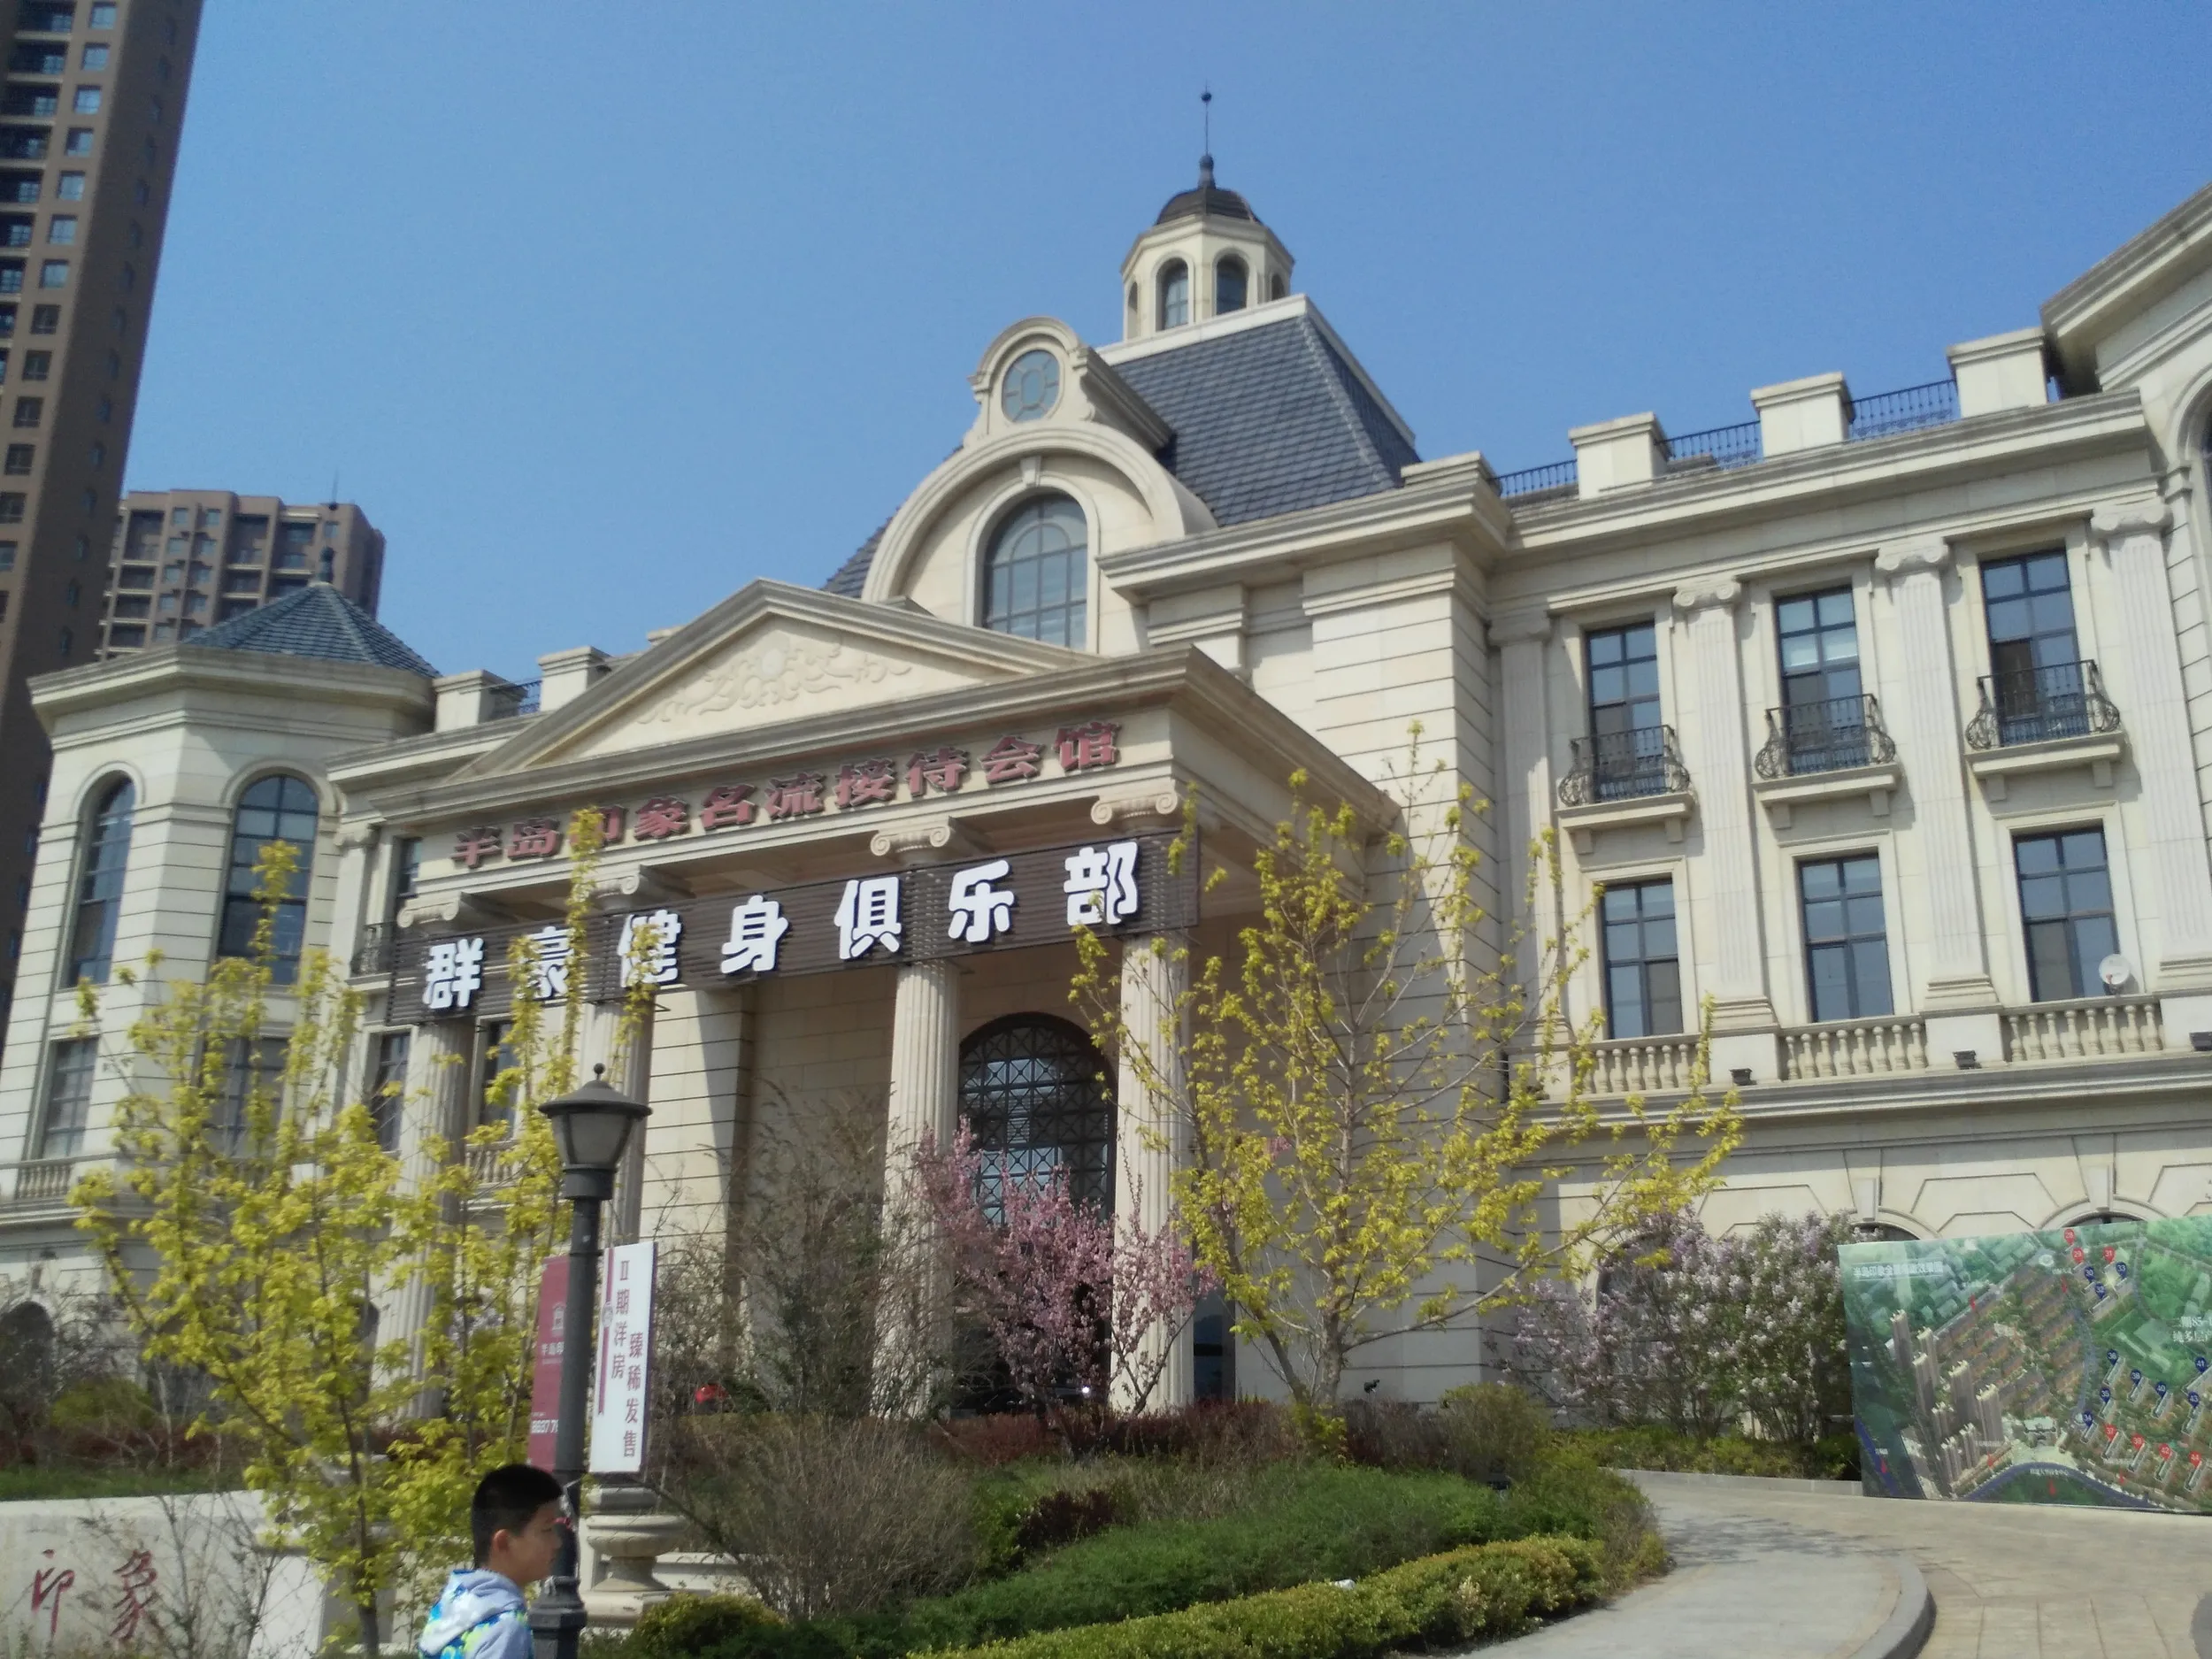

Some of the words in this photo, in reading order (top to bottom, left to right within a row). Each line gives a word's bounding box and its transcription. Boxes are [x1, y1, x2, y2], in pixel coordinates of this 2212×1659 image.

[422, 841, 1139, 1010] 群豪健身俱乐部
[623, 1332, 643, 1457] 臻稀发售
